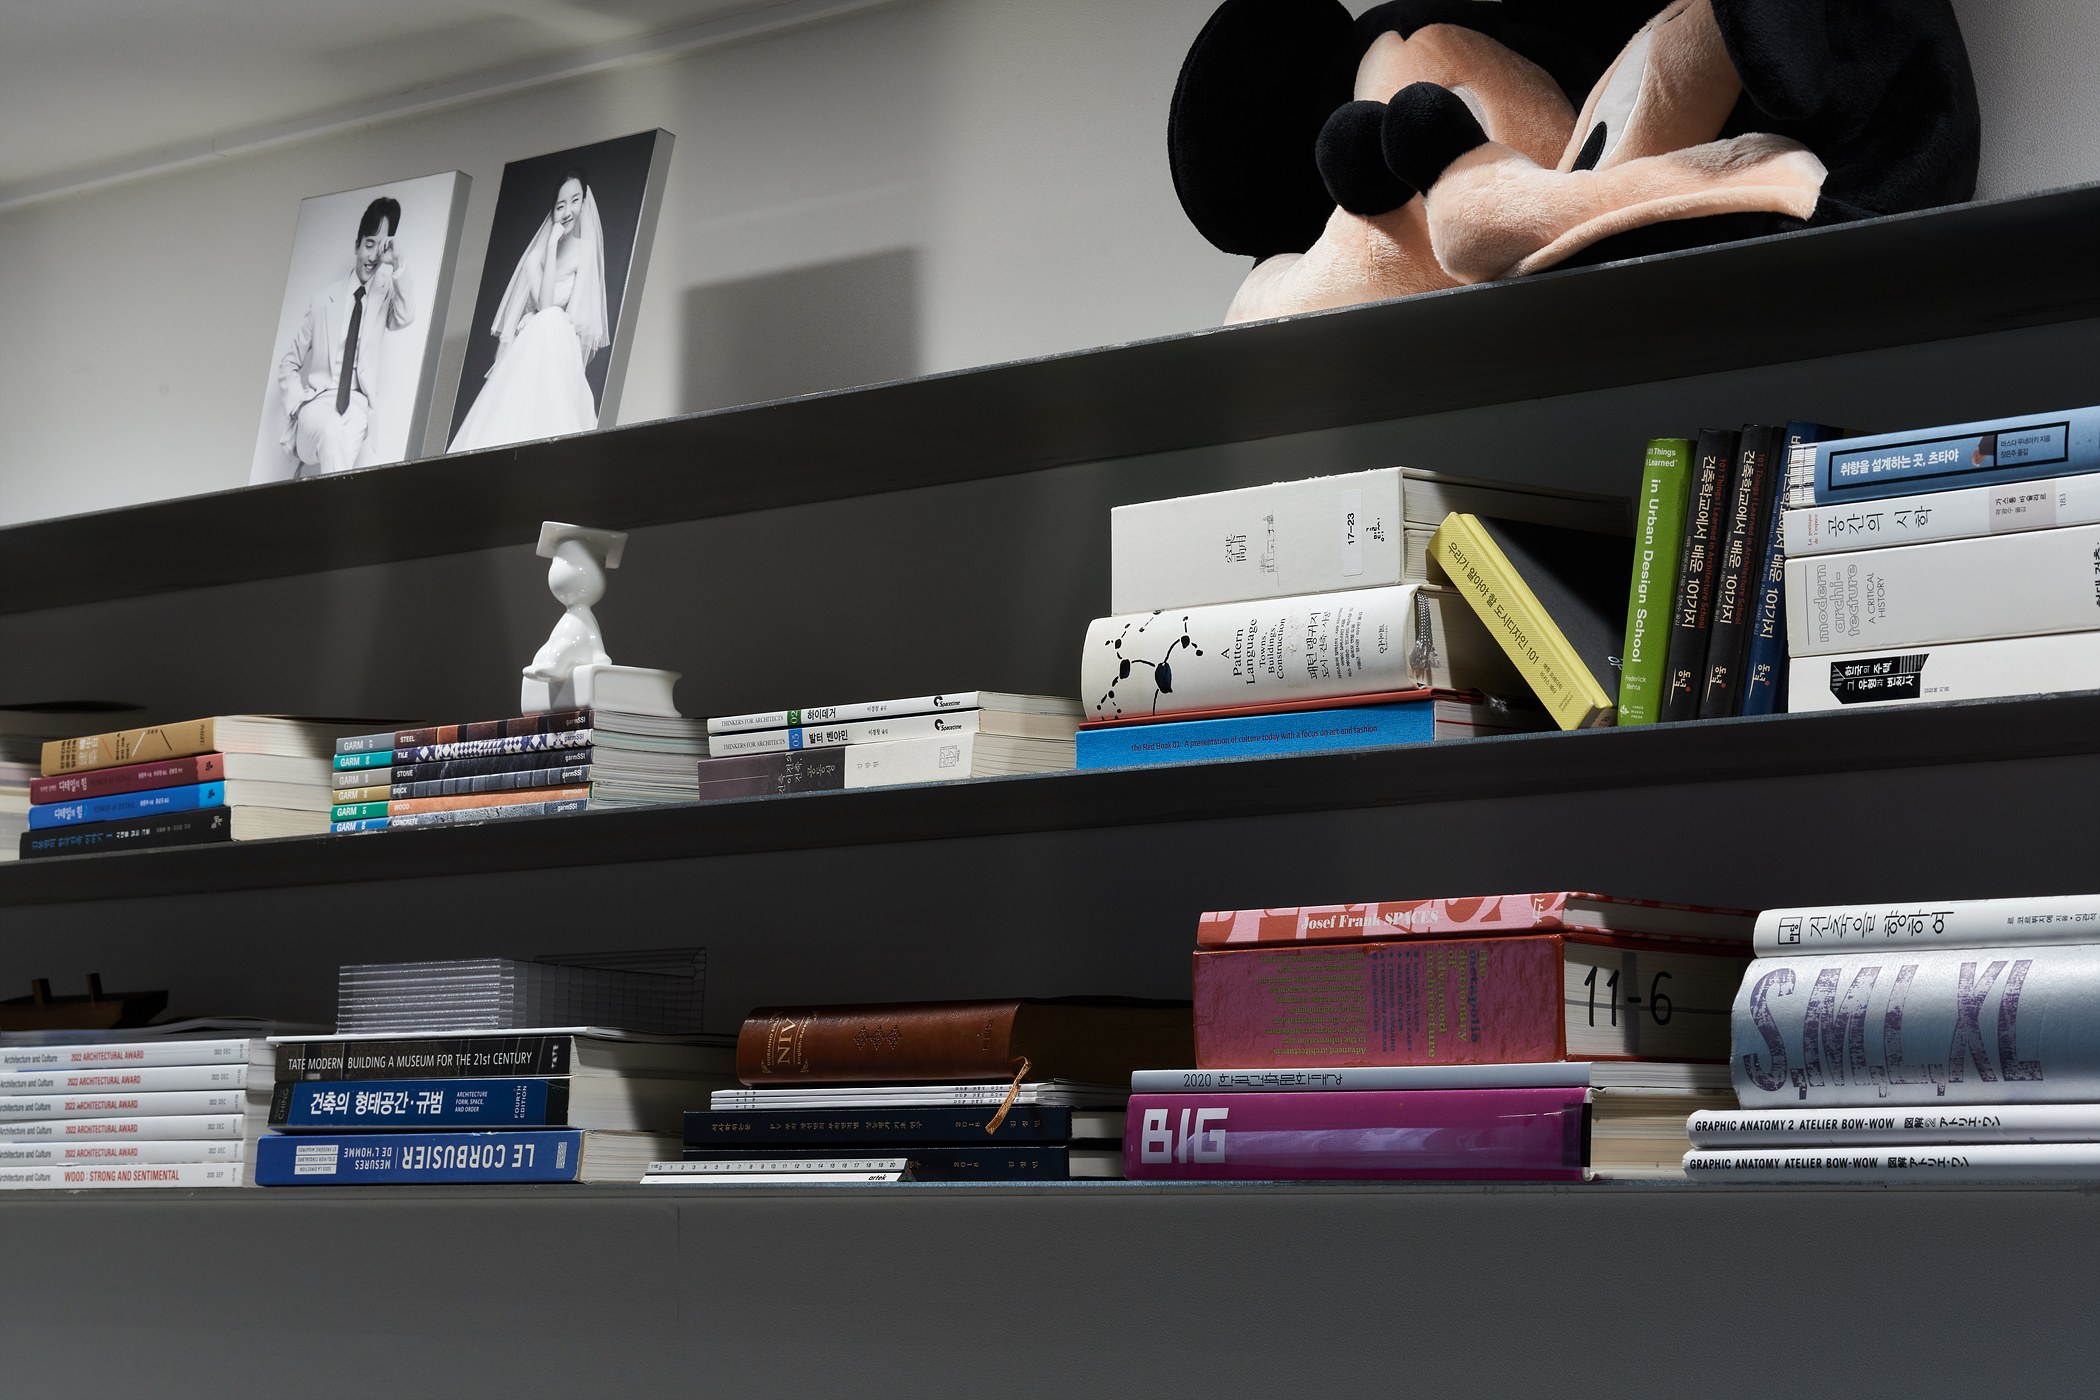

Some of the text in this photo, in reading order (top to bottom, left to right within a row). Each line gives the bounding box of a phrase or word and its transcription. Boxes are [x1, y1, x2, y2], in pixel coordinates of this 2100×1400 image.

[1654, 448, 1676, 457] Things
[1840, 448, 1959, 476] 취향을 설계하는 곳, 츠타야
[2059, 493, 2067, 507] 183
[1828, 505, 1933, 537] 공간의 시학
[1682, 455, 1716, 628] 건축학교에서 배운 101가지
[1720, 450, 1755, 625] 건축학교에서 배운 101가지
[1632, 479, 1661, 663] in Urban Design School
[1448, 542, 1540, 665] 우리가 알아야 할 도시디자인 101
[1760, 553, 1783, 639] 배운 101가지
[1813, 564, 1830, 643] modern
[1829, 571, 1846, 634] archi-
[1846, 564, 1860, 637] tecture
[1866, 572, 1876, 625] A CRITICAL
[1877, 577, 1886, 618] HISTORY
[1221, 647, 1230, 659] A
[1233, 628, 1243, 677] Pattern
[1246, 618, 1258, 685] Language
[1259, 632, 1267, 668] Towns,
[1268, 623, 1277, 674] Buildings,
[1276, 618, 1287, 680] Construction
[1306, 611, 1322, 681] 패턴 랭귀지
[1845, 660, 1893, 677] 한국의 주택,
[1847, 675, 1915, 691] 그 유형과 변천사
[721, 719, 744, 727] THINKERS
[755, 715, 784, 724] ARCHITECTS
[791, 710, 798, 724] 02
[807, 707, 837, 720] 하이데거
[939, 700, 960, 708] Spacetime
[344, 740, 364, 751] GARM
[757, 739, 786, 747] ARCHITECTS
[792, 733, 800, 747] 05
[808, 732, 823, 744] 발터
[827, 729, 848, 742] 벤야민
[1131, 744, 1141, 752] the
[1142, 743, 1155, 751] Red
[1156, 741, 1172, 750] Book
[1184, 740, 1190, 748] A
[1190, 737, 1230, 748] presentation
[1230, 736, 1237, 744] of
[1238, 733, 1261, 743] culture
[1262, 731, 1280, 743] today
[1280, 731, 1295, 740] with
[1301, 728, 1319, 738] focus
[1320, 729, 1328, 737] on
[1329, 728, 1340, 736] art
[1340, 726, 1353, 736] and
[1353, 724, 1378, 735] fashion
[340, 757, 360, 766] GARM
[785, 753, 793, 784] 이전의
[807, 764, 836, 778] 공동성
[339, 770, 413, 785] GARM STONE
[778, 774, 786, 794] 건축
[339, 787, 408, 800] GARM BRICK
[337, 807, 357, 816] GARM
[337, 824, 356, 832] GARM
[1301, 909, 1439, 930] Josef Frank SPACES
[1809, 908, 1955, 938] 건축을 향하여
[1427, 949, 1436, 1057] architecture
[1438, 950, 1448, 1032] advanced
[1458, 949, 1468, 1040] dictionary
[1584, 965, 1675, 1028] 11-6
[777, 1018, 798, 1065] NIV
[1743, 959, 2044, 1100] S,M,L,XL
[4, 1050, 144, 1064] Architecture and Culture ARCHITECTURAL AWARD
[288, 1051, 533, 1071] TATE MODERN BUILDING A MUSEUM FOR THE 21st CENTURY
[1183, 1072, 1343, 1088] 2020 한국건축문화대상
[310, 1091, 350, 1115] 건축의
[520, 1085, 528, 1119] EDITION
[1141, 1107, 1230, 1164] BIG
[1695, 1120, 1737, 1132] GRAPHIC
[1740, 1120, 1786, 1131] ANATOMY
[1788, 1119, 1794, 1130] 2
[1800, 1119, 1838, 1130] ATELIER
[1842, 1118, 1895, 1130] BOW-WOW
[344, 1147, 392, 1158] DE L'HOMME
[355, 1159, 391, 1170] MESURES
[401, 1145, 506, 1170] CORBUSIER
[512, 1144, 535, 1168] LE
[1690, 1158, 1731, 1170] GRAPHIC
[1735, 1158, 1780, 1170] ANATOMY
[1784, 1157, 1823, 1169] ATELIER
[1826, 1157, 1879, 1169] BOW-WOW
[64, 1169, 180, 1182] WOOD STRONG AND SENTIMENTAL
